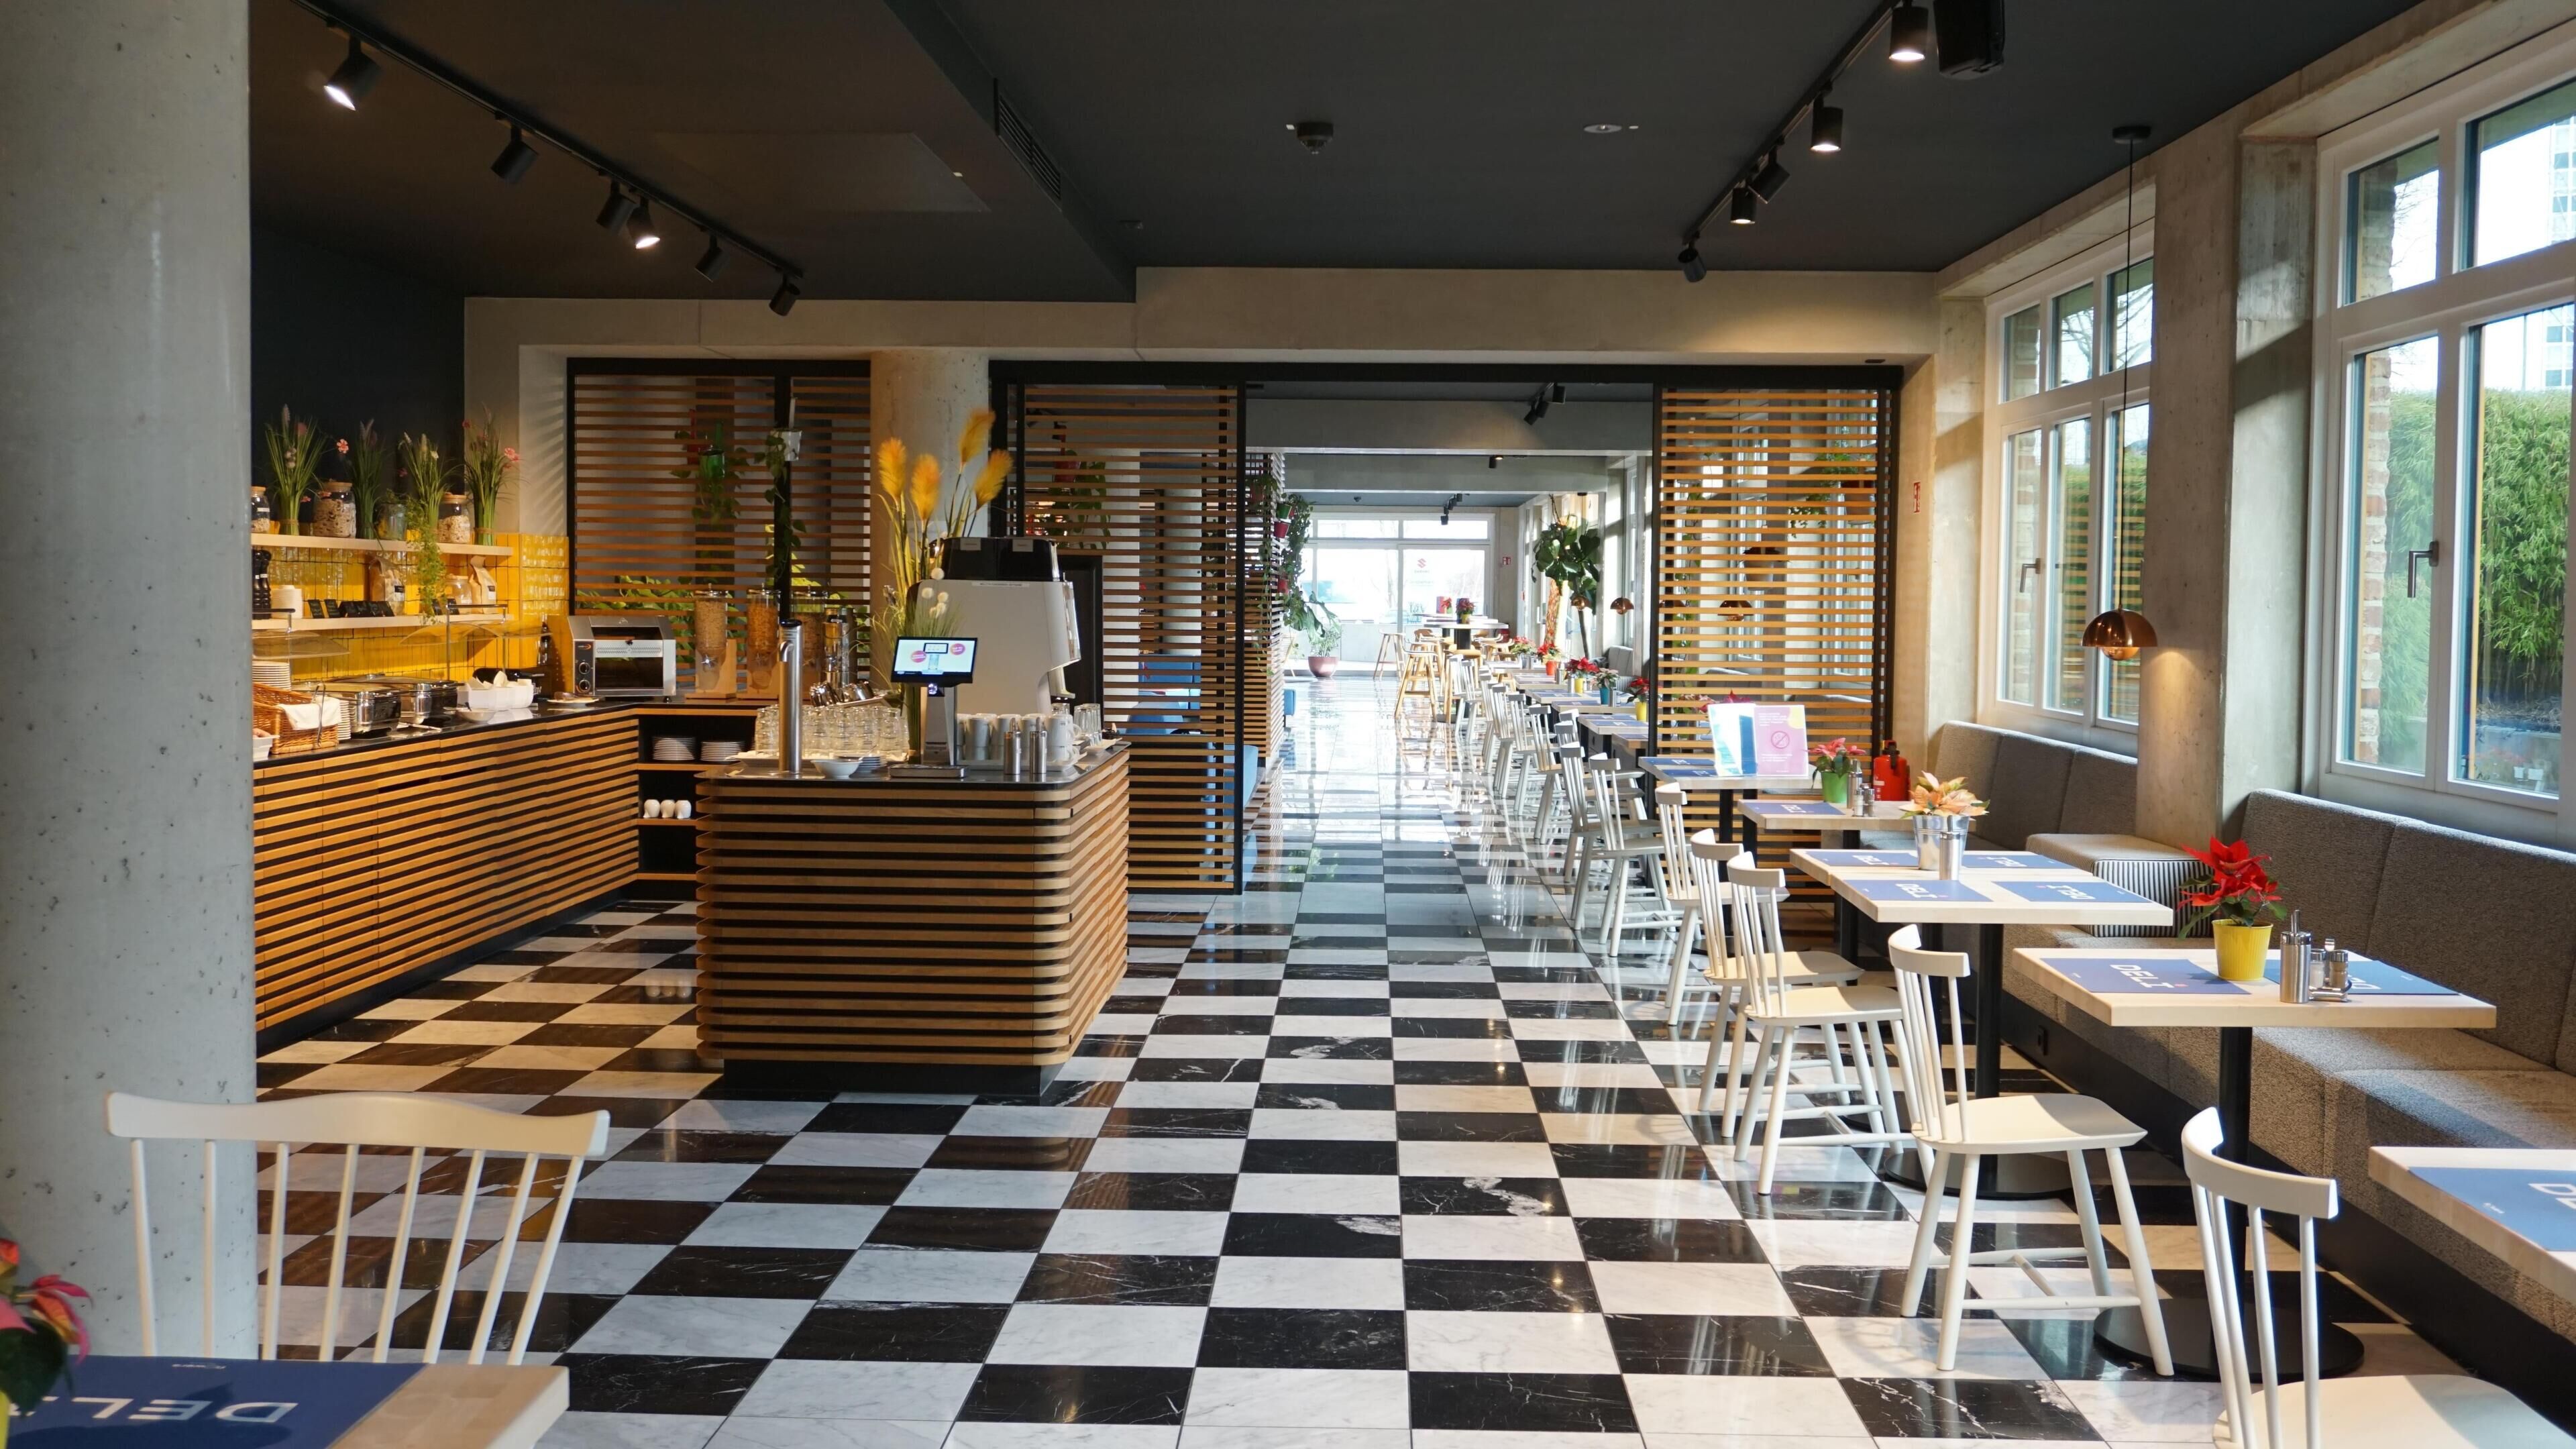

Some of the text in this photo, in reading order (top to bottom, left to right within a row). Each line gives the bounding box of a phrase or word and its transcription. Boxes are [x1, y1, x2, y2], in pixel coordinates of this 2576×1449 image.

[1895, 883, 1938, 898] DELI
[2046, 885, 2096, 900] DELI
[2110, 964, 2175, 988] DELI
